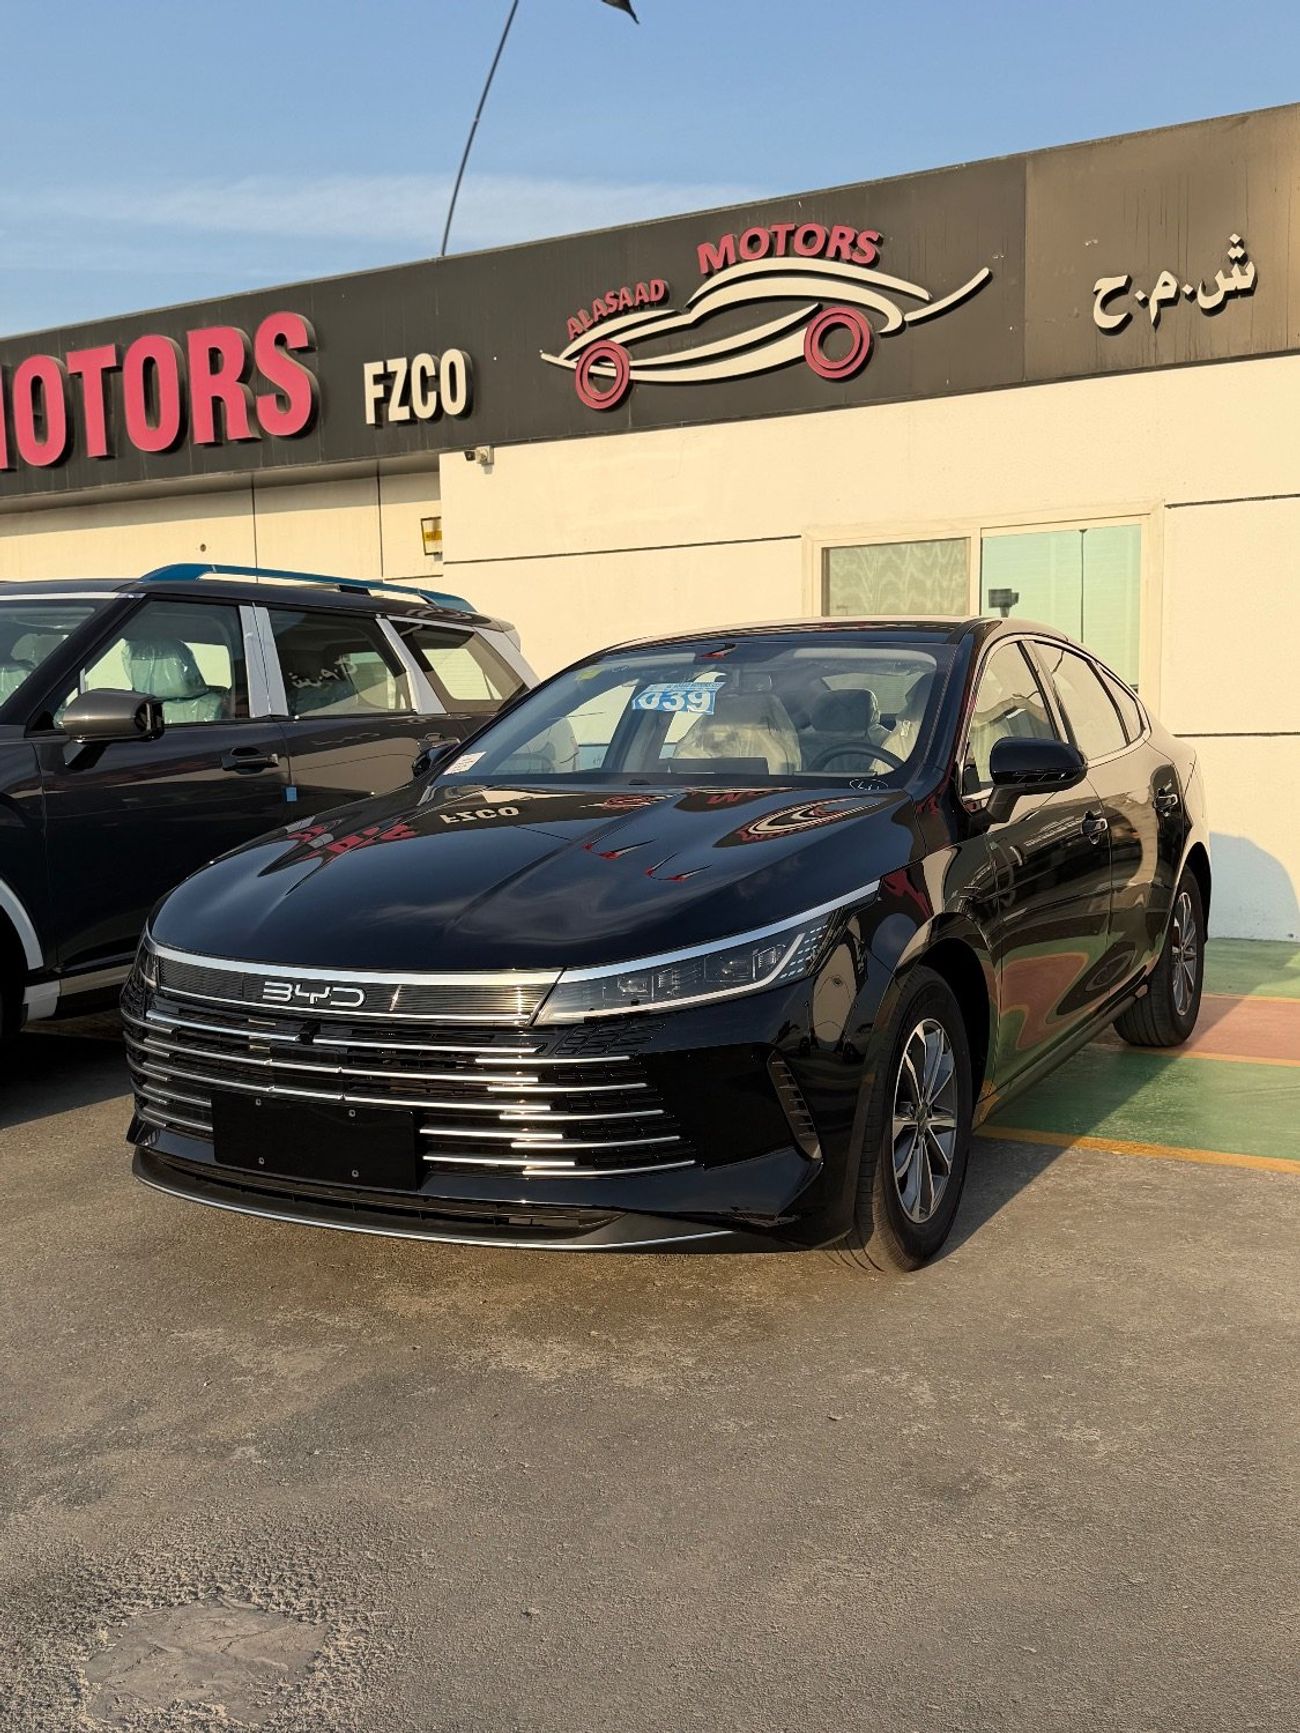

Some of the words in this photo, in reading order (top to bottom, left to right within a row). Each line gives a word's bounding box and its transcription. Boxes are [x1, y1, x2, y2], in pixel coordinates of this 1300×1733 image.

[697, 223, 881, 274] MOTORS
[566, 279, 666, 339] ALASAAD
[0, 311, 312, 468] OTORS
[364, 348, 468, 425] FZCO
[262, 980, 366, 1008] BYD
